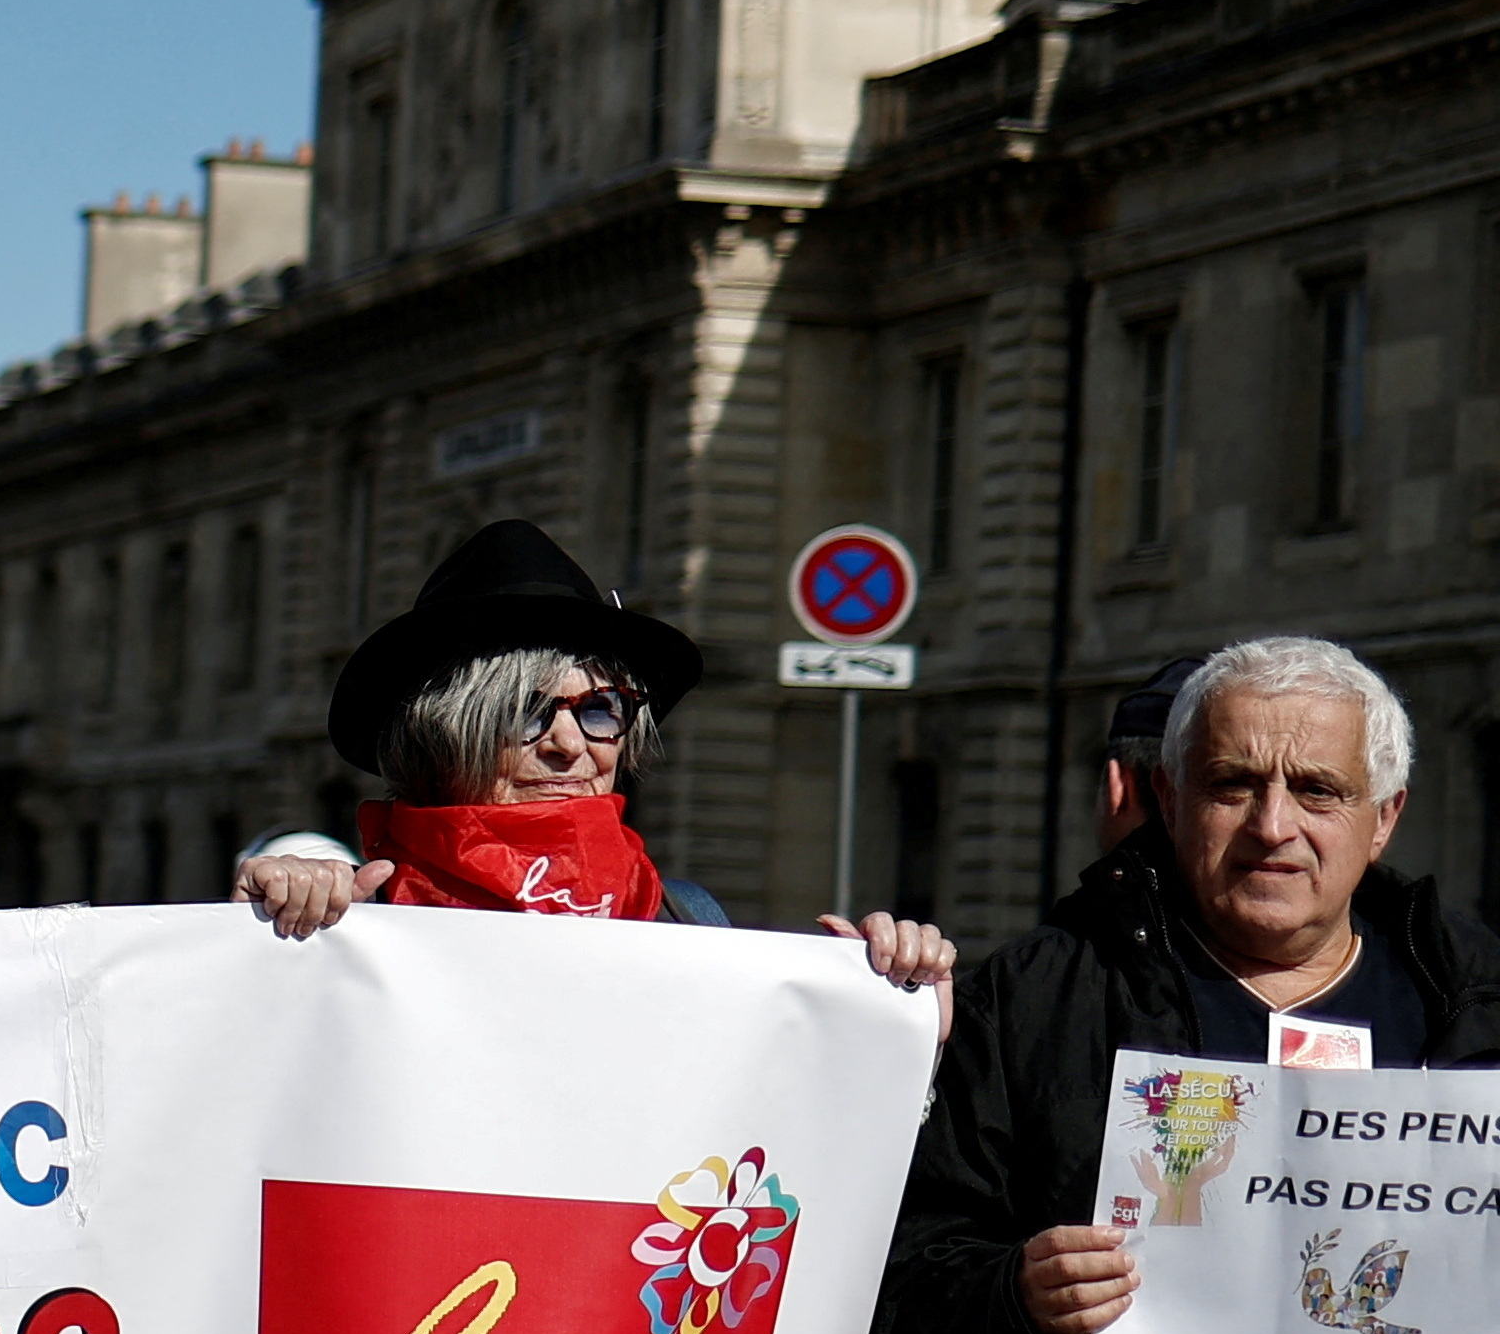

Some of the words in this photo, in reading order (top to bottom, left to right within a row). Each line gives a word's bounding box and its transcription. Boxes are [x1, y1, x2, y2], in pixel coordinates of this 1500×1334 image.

[515, 855, 602, 911] la
[1149, 1082, 1173, 1098] LA
[1176, 1105, 1219, 1117] VITALE
[1150, 1118, 1188, 1130] POUR
[1192, 1119, 1238, 1132] TOUTES
[1295, 1108, 1388, 1141] DES
[1167, 1134, 1181, 1145] ET
[1184, 1134, 1217, 1145] TOUS
[1245, 1175, 1330, 1208] PAS
[1341, 1181, 1433, 1213] DES
[1112, 1205, 1140, 1221] cgt
